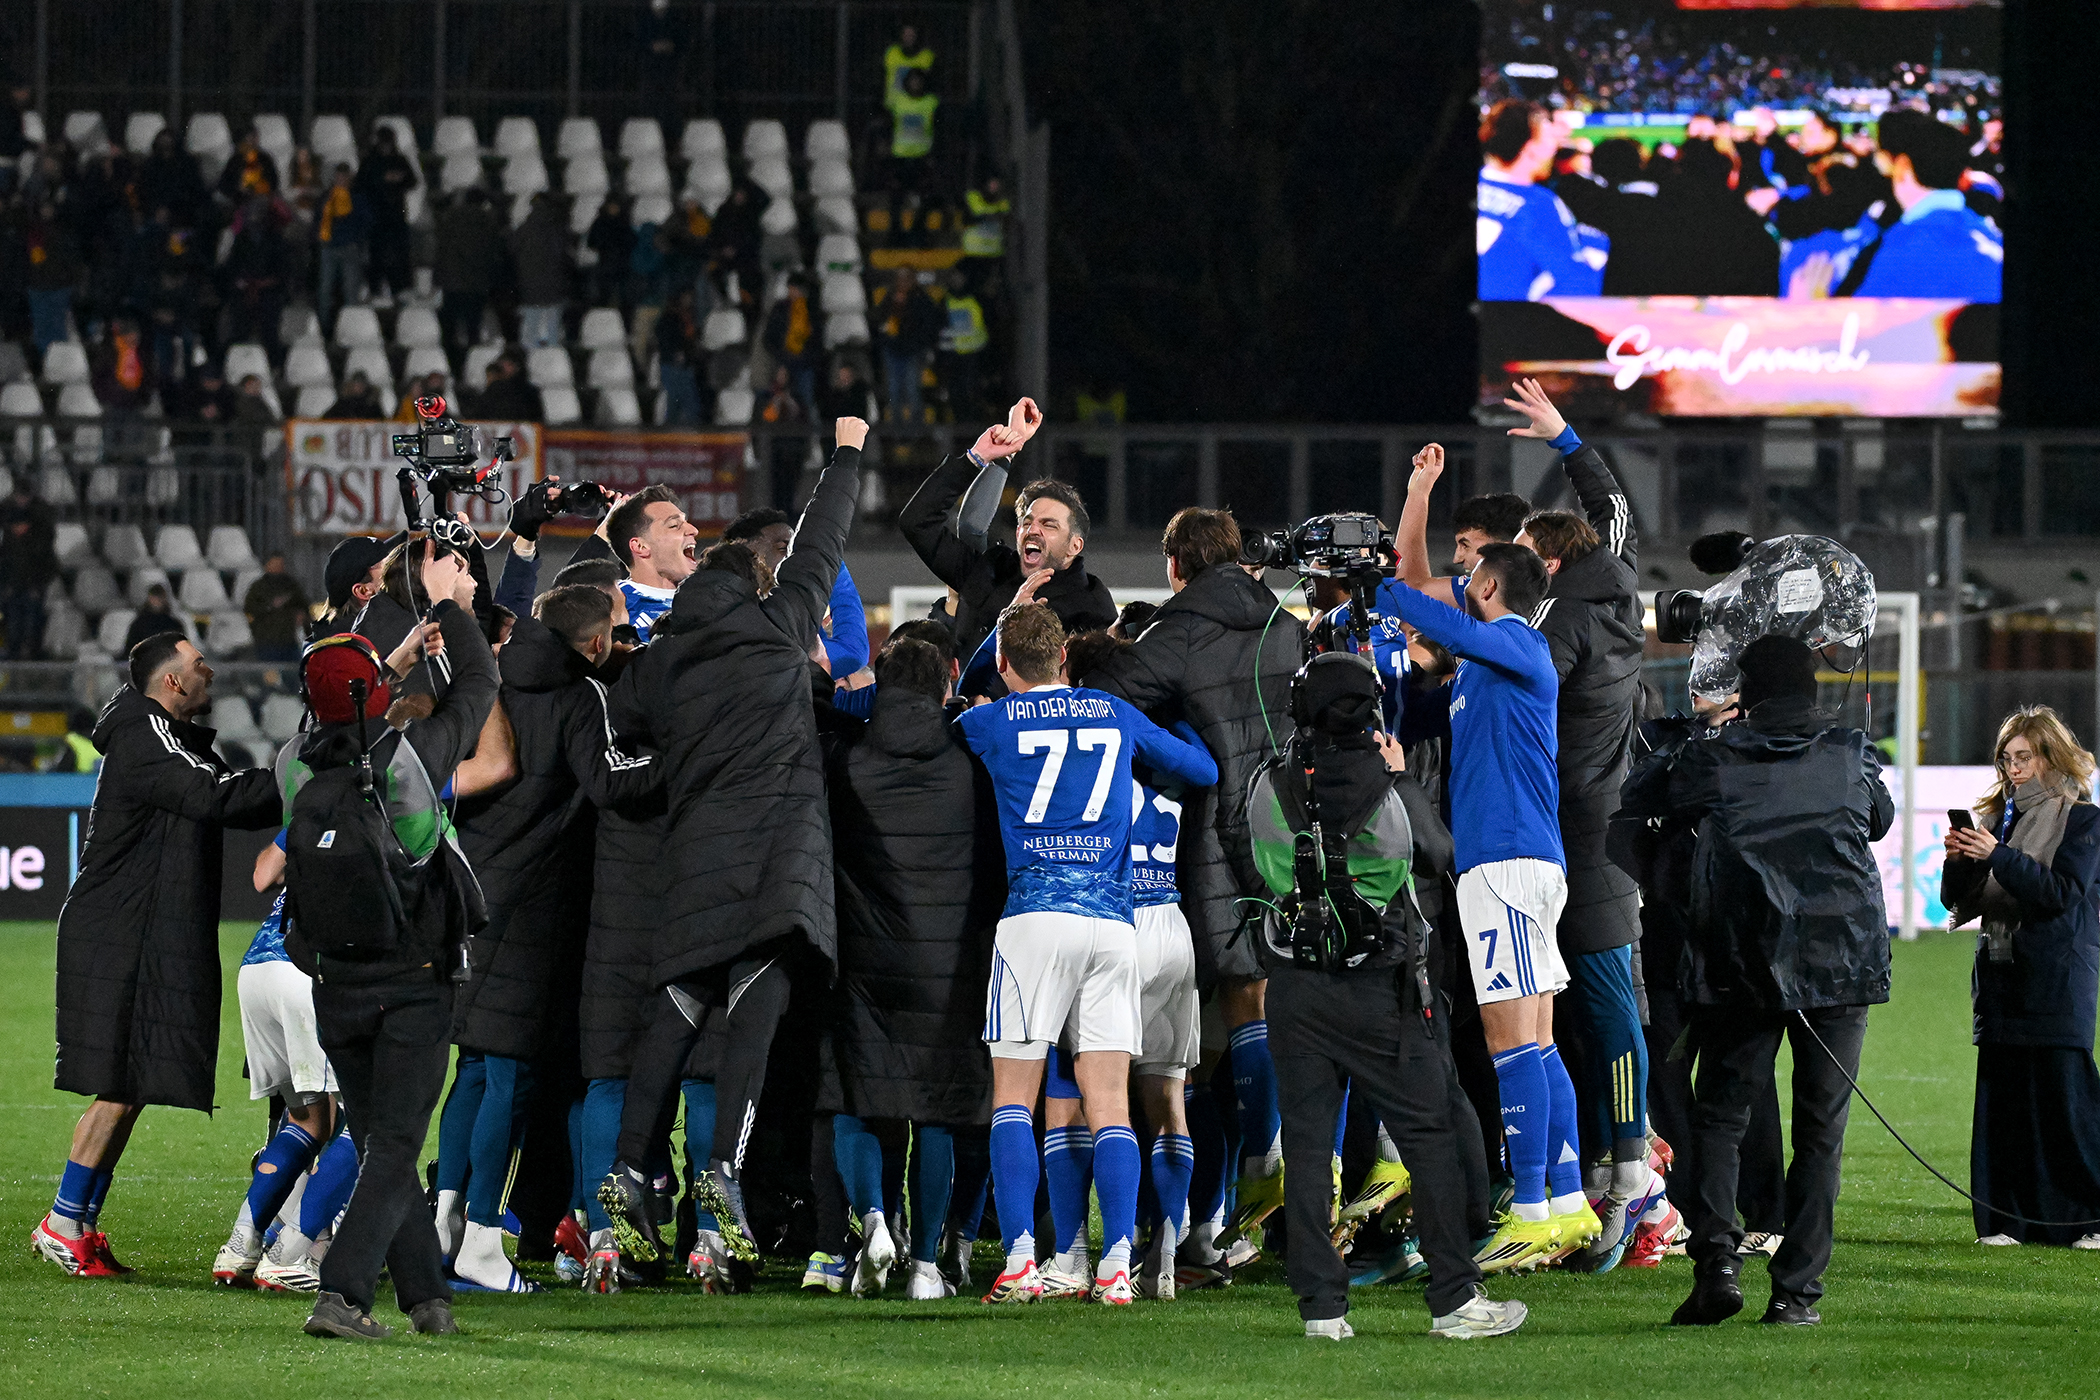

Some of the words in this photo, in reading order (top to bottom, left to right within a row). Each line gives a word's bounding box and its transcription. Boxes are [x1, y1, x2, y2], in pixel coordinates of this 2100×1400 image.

[1006, 700, 1036, 721] VAN
[1039, 697, 1067, 718] DER
[1068, 697, 1117, 718] BREMPT
[1018, 728, 1122, 823] 77
[1023, 835, 1113, 850] NEUBERGER
[1132, 867, 1176, 884] UBERG
[1479, 928, 1498, 970] 7
[1500, 1104, 1526, 1115] OMO
